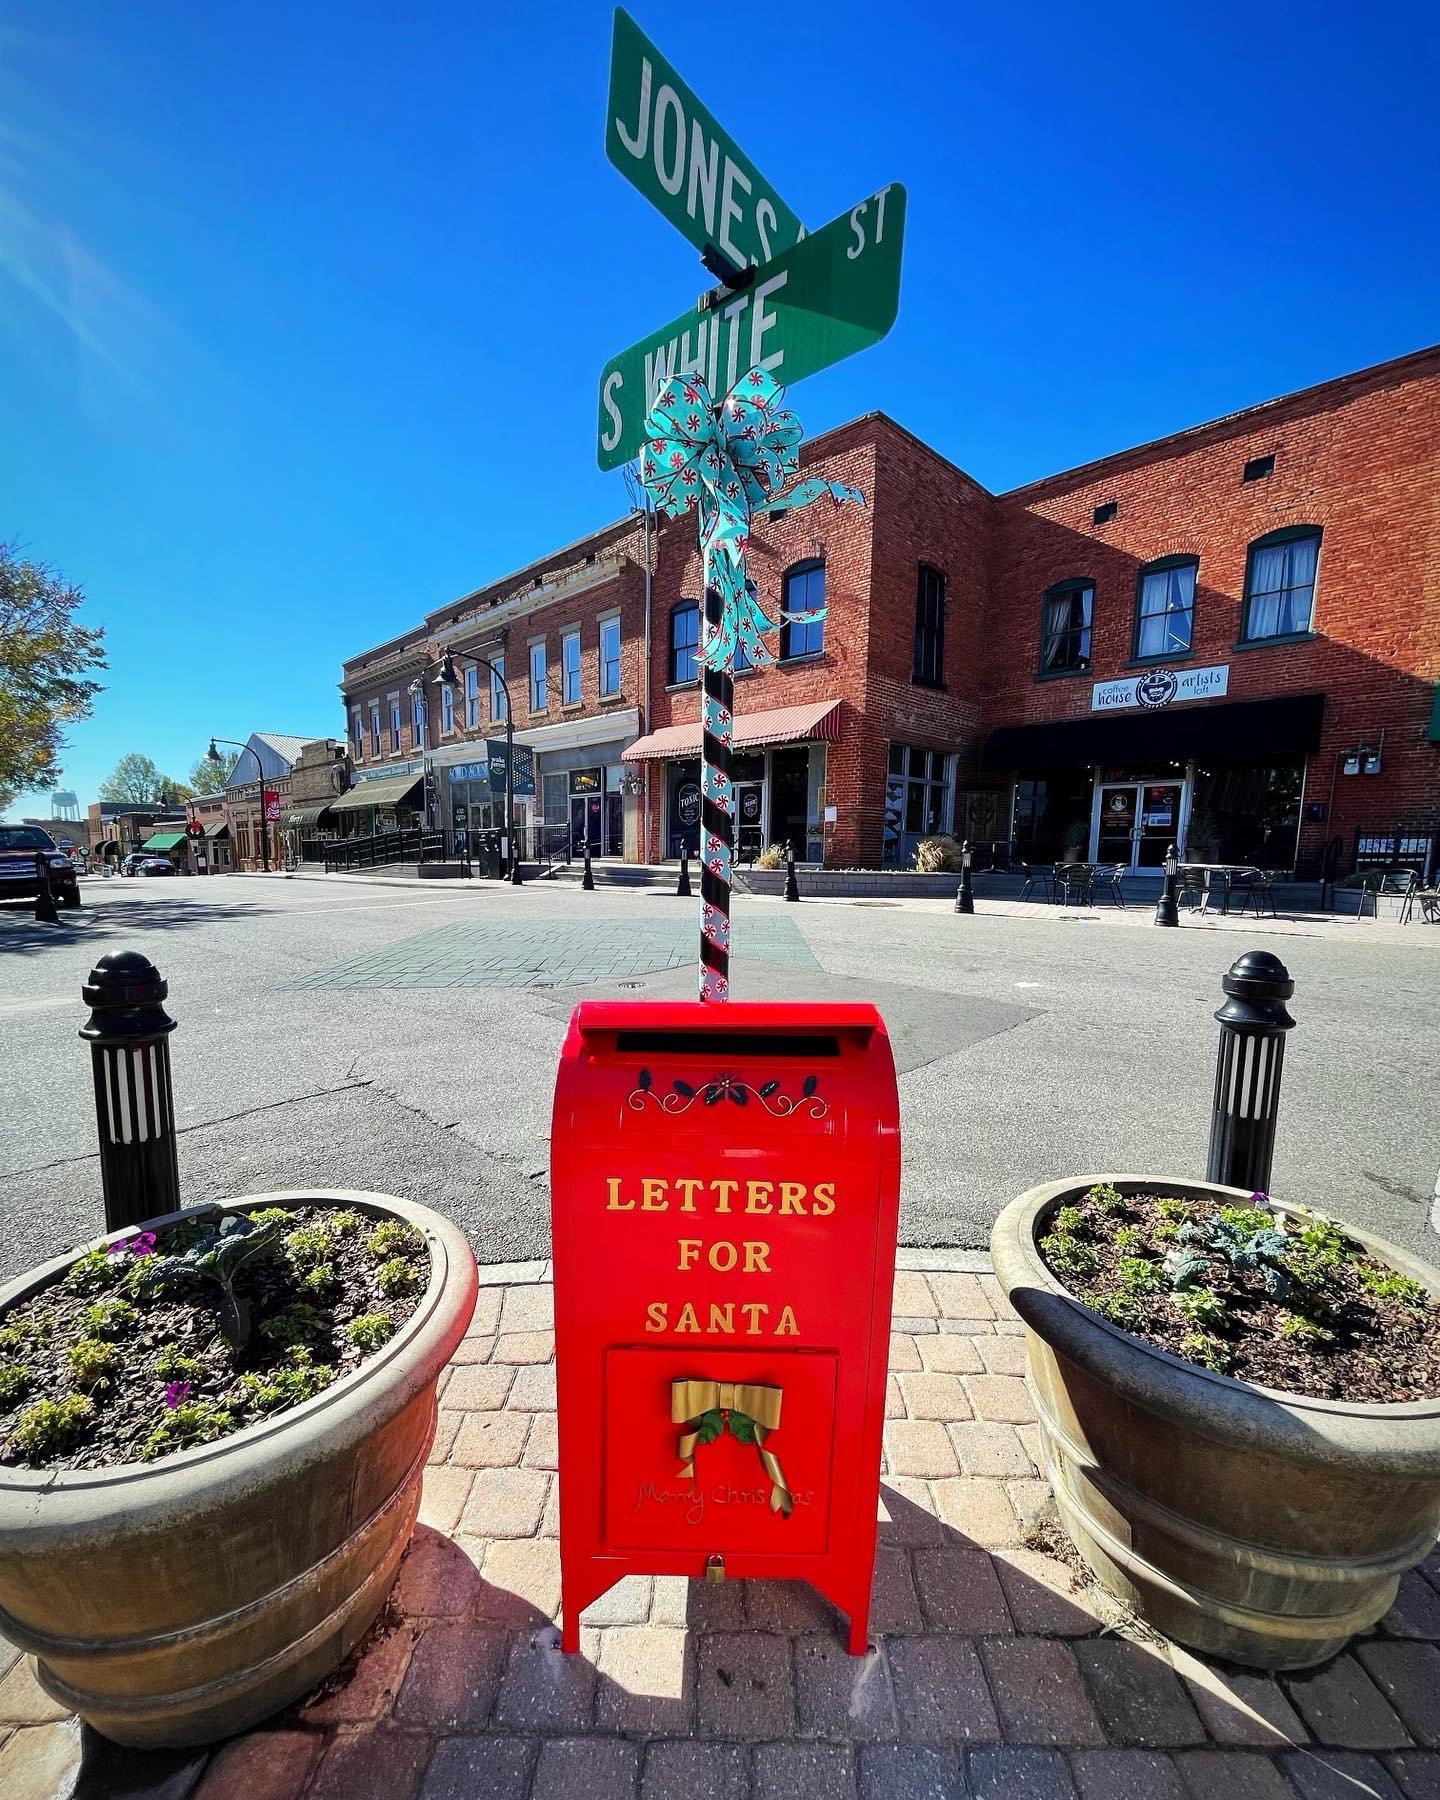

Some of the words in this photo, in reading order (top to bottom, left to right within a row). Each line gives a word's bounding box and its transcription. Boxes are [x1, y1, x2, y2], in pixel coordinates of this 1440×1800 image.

[616, 57, 777, 270] JONES
[601, 370, 624, 451] S
[644, 270, 788, 420] WHITE
[847, 185, 892, 260] ST
[1102, 684, 1130, 694] coffee
[1181, 671, 1221, 687] artists
[1193, 686, 1209, 695] loft
[1098, 692, 1132, 706] house
[680, 792, 700, 808] TOXIC
[606, 1178, 836, 1216] LETTERS
[677, 1240, 772, 1272] FOR
[645, 1303, 801, 1336] SANTA
[712, 1480, 815, 1506] Chrisas
